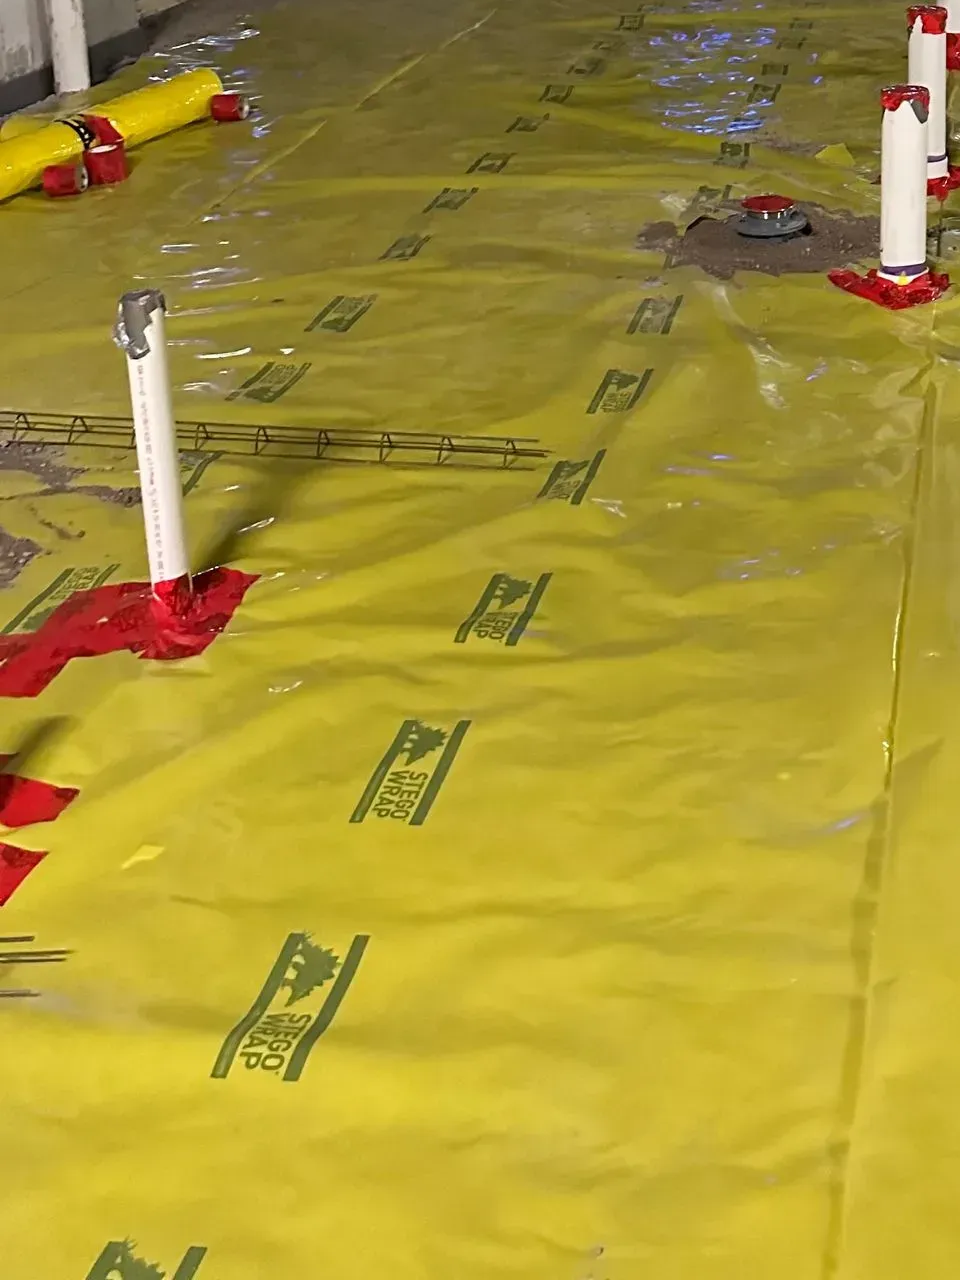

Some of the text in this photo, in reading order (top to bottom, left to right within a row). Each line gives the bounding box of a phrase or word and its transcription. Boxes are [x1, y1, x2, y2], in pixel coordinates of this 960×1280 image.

[371, 770, 410, 818] WRAP
[390, 771, 428, 819] STEGO
[239, 1012, 290, 1069] WRAP
[261, 1013, 312, 1071] STEGO
